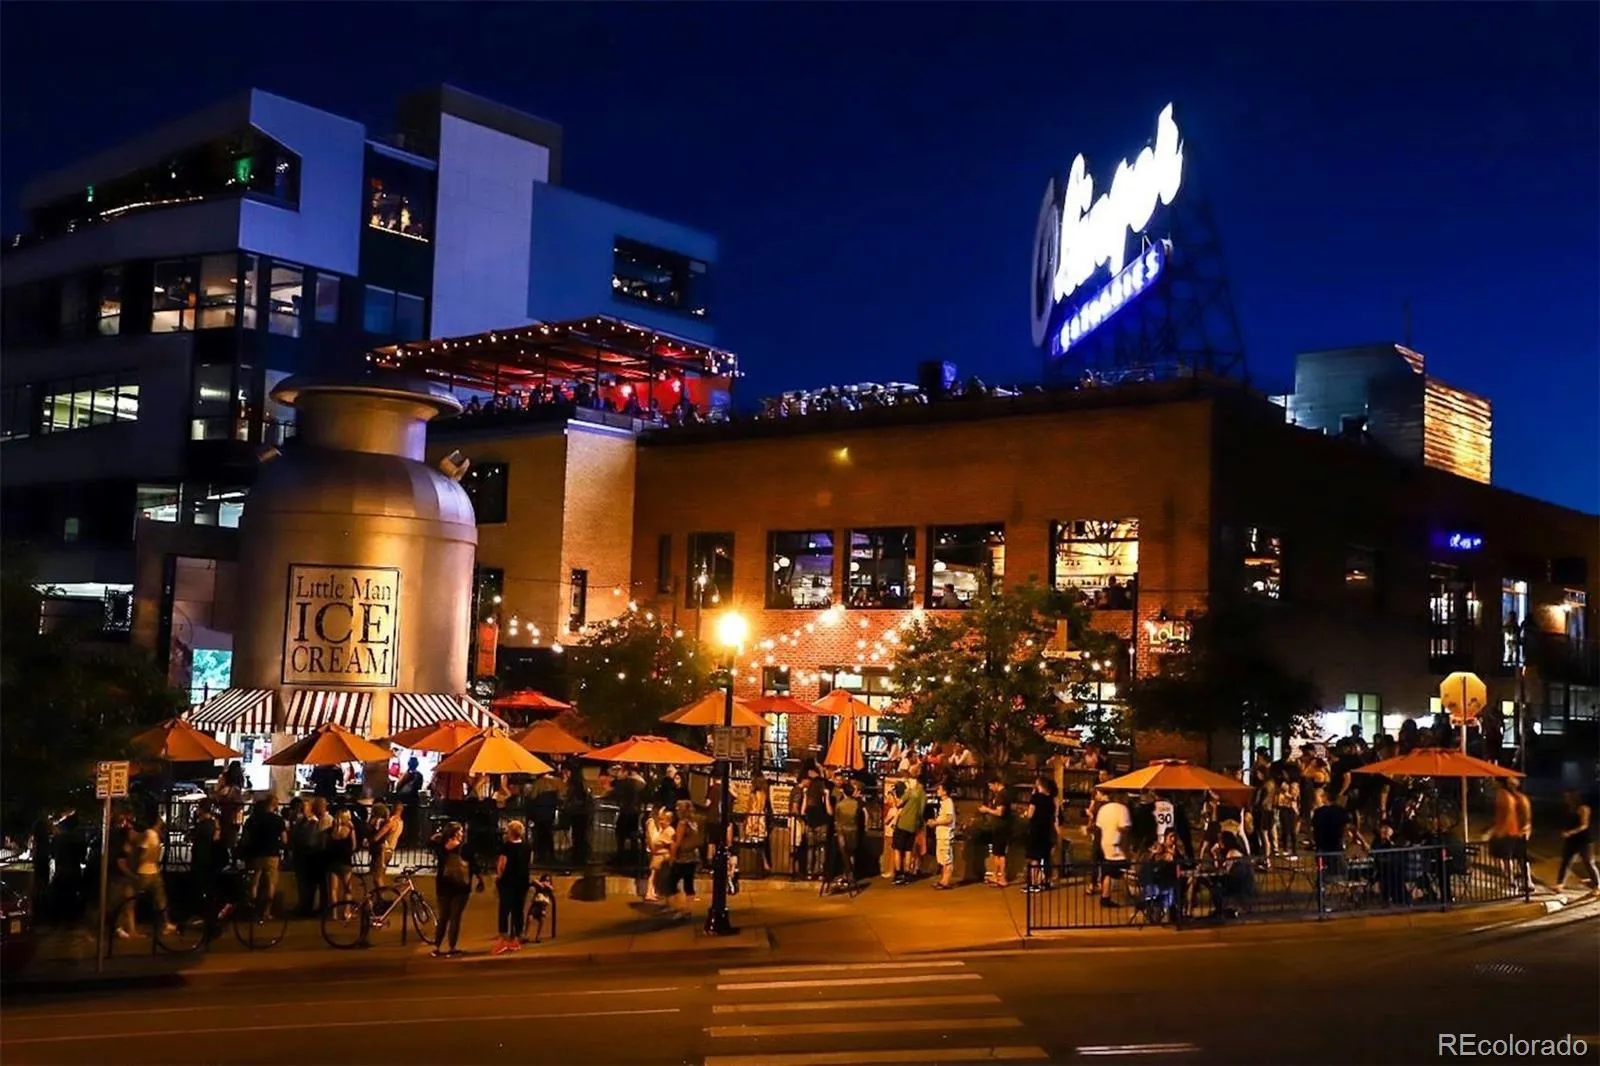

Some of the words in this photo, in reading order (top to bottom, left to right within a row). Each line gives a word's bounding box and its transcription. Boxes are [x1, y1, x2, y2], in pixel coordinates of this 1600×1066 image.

[296, 574, 345, 599] Little
[350, 577, 391, 601] Man
[293, 602, 390, 645] ICE
[291, 645, 389, 675] CREAM
[1157, 813, 1171, 825] 30
